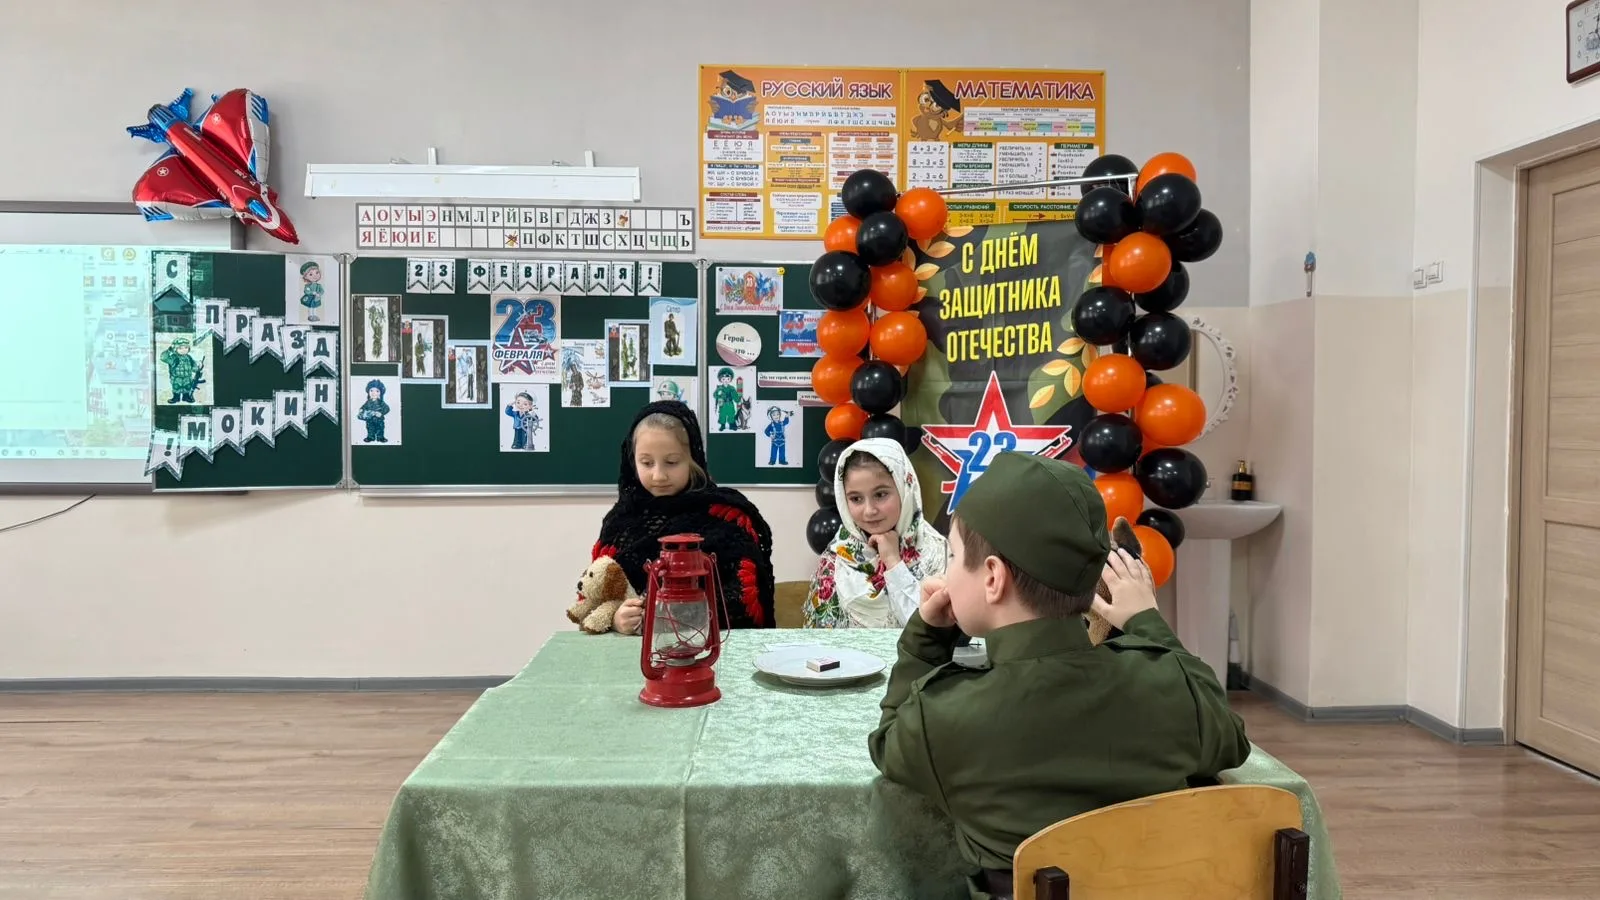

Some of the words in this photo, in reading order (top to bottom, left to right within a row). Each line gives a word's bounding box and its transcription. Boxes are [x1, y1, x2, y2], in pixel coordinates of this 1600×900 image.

[761, 78, 843, 99] РУССКИЙ
[848, 82, 892, 100] ЯЗЫК
[955, 80, 1095, 100] МАТЕМАТИКА
[362, 211, 372, 221] А
[377, 211, 388, 221] О
[394, 211, 404, 222] У
[408, 211, 421, 222] Ы
[426, 211, 436, 222] Э
[442, 211, 452, 222] Н
[457, 211, 470, 222] М
[474, 212, 484, 222] Л
[492, 212, 500, 223] Р
[507, 209, 517, 223] Й
[524, 212, 533, 223] Б
[540, 212, 548, 223] В
[556, 212, 565, 223] Г
[570, 213, 581, 225] Д
[584, 213, 598, 224] Ж
[603, 213, 611, 224] З
[679, 214, 691, 225] Ъ
[362, 232, 372, 243] Я
[378, 230, 387, 243] Ё
[392, 232, 407, 243] Ю
[410, 233, 420, 243] И
[427, 233, 436, 243] Е
[523, 234, 533, 245] П
[538, 234, 550, 245] Ф
[556, 235, 565, 245] К
[571, 235, 580, 245] Т
[584, 235, 599, 245] Ш
[603, 235, 613, 246] С
[618, 235, 628, 246] Х
[633, 236, 645, 248] Ц
[650, 236, 659, 246] Ч
[662, 236, 677, 248] Щ
[681, 236, 690, 247] Ь
[962, 242, 974, 273] С
[980, 233, 1038, 274] ДНЁМ
[166, 260, 177, 278] С
[414, 265, 448, 277] 23
[939, 276, 1061, 320] ЗАЩИТНИКА
[495, 299, 556, 344] 23
[724, 334, 744, 343] Герой
[947, 321, 1052, 362] ОТЕЧЕСТВА
[494, 350, 543, 361] ФЕВРАЛЯ
